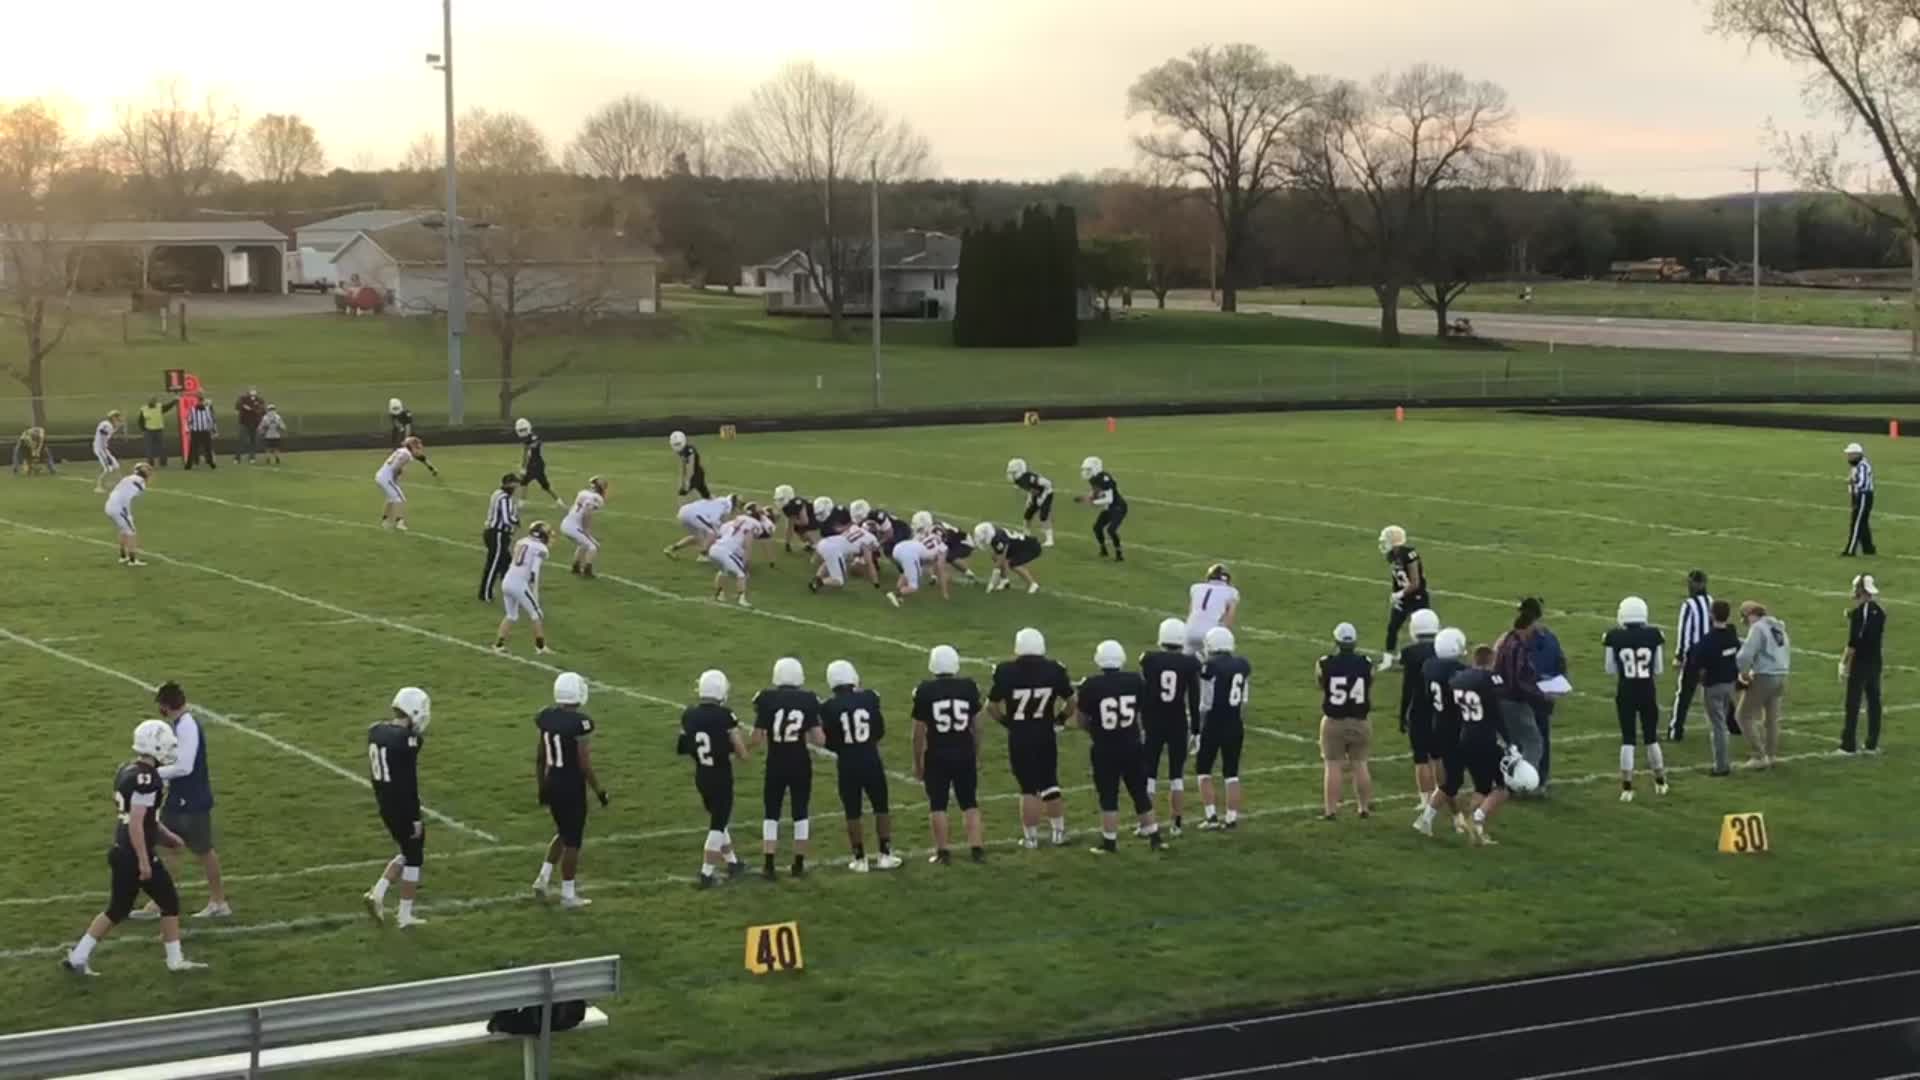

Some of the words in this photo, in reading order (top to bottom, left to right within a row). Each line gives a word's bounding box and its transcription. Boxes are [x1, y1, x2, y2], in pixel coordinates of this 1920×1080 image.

[169, 371, 183, 390] 1
[1202, 588, 1217, 611] 1
[1618, 647, 1651, 678] 82
[1160, 670, 1177, 702] 9
[1329, 677, 1365, 705] 54
[932, 699, 970, 733] 55
[1012, 688, 1053, 721] 77
[1100, 695, 1137, 730] 65
[773, 708, 804, 743] 12
[839, 708, 870, 744] 16
[543, 731, 564, 768] 11
[695, 731, 714, 766] 2
[1730, 815, 1765, 852] 30
[756, 927, 798, 970] 40
